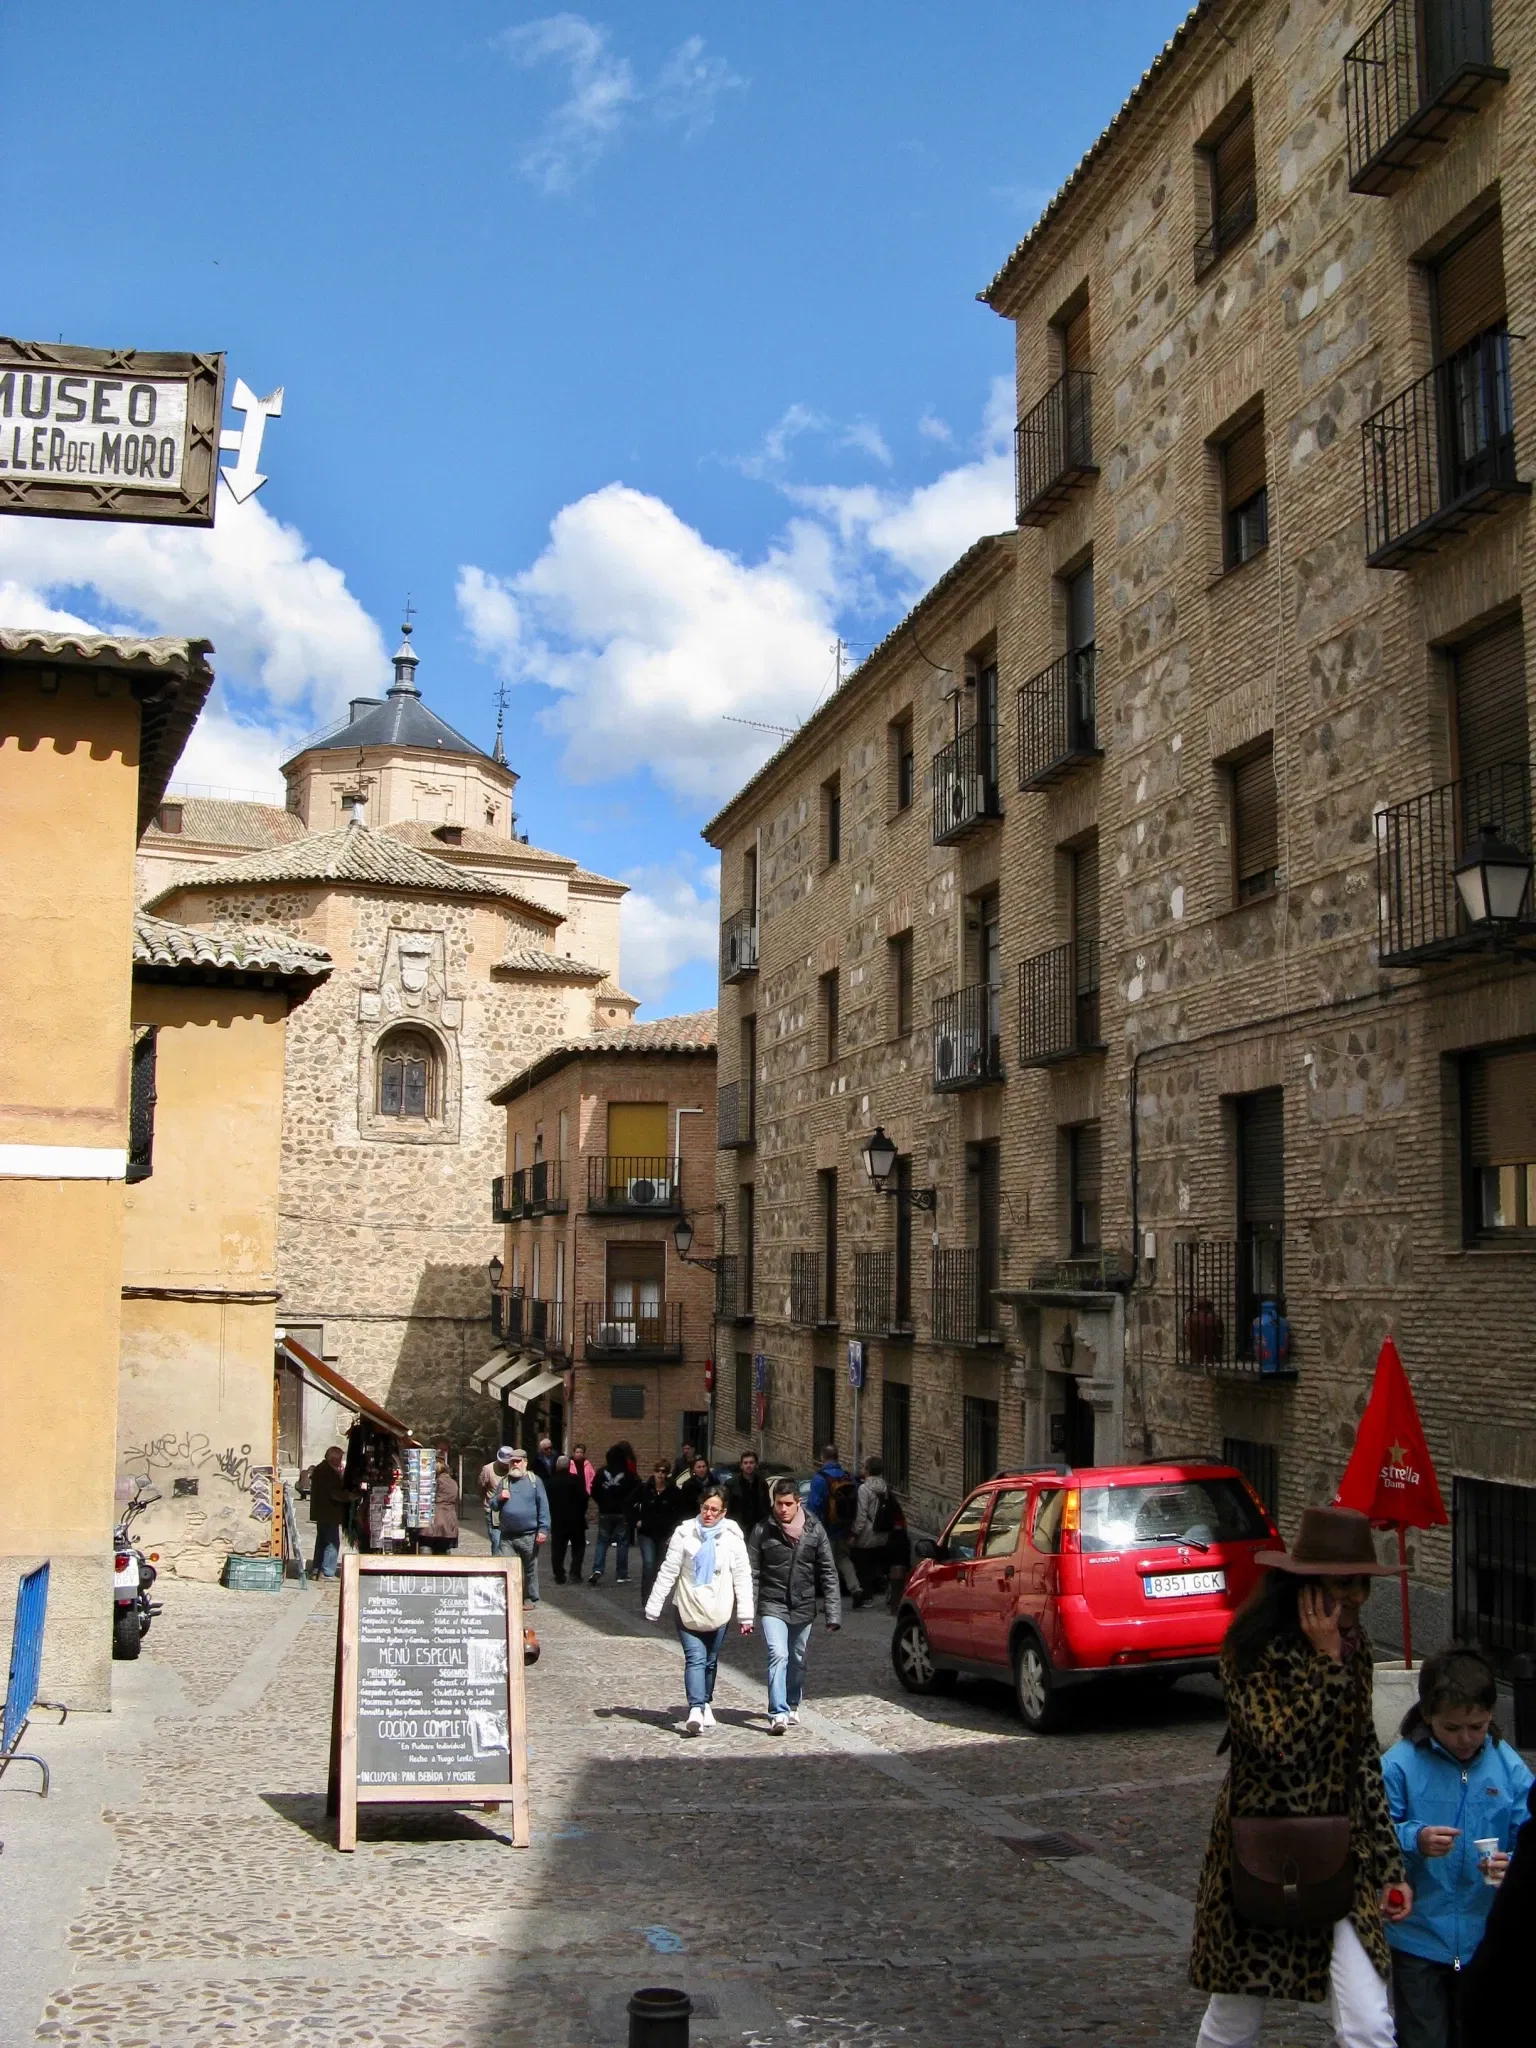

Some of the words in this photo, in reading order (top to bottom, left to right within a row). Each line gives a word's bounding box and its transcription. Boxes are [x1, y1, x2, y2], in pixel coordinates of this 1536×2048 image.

[66, 440, 98, 474] DEL
[100, 431, 176, 479] MORO
[1379, 1464, 1420, 1485] strella
[1154, 1576, 1186, 1592] 8351
[1193, 1573, 1221, 1589] GCK
[416, 1646, 466, 1665] ESPECIAL
[378, 1719, 418, 1738] COCIDO
[453, 1771, 477, 1782] POSTRE
